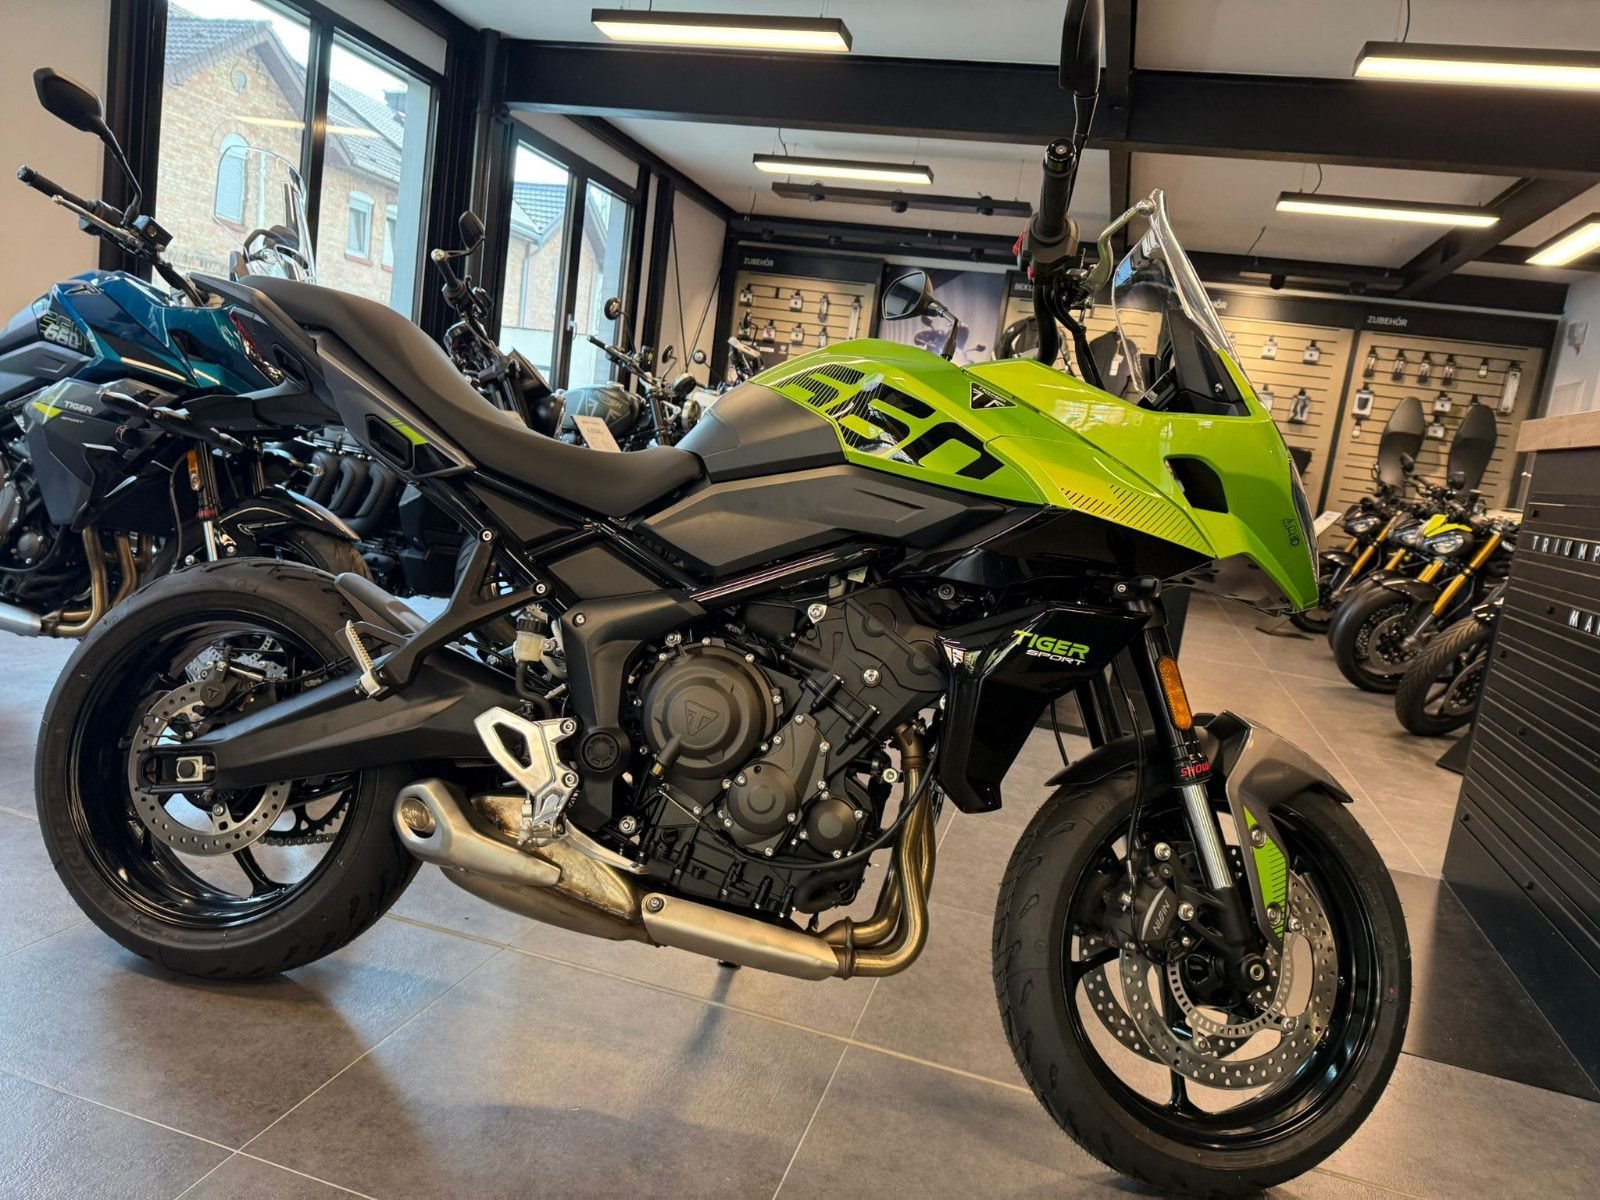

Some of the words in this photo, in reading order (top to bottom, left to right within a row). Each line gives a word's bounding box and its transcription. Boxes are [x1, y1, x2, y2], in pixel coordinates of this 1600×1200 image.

[743, 257, 774, 267] ZUBEHÖR
[1367, 314, 1408, 328] ZUBEHÖR
[64, 400, 93, 414] TIGER
[1531, 535, 1600, 562] TRIUMP
[1013, 629, 1090, 660] TIGER
[1025, 649, 1086, 666] SPORT
[1180, 762, 1212, 777] SHOW
